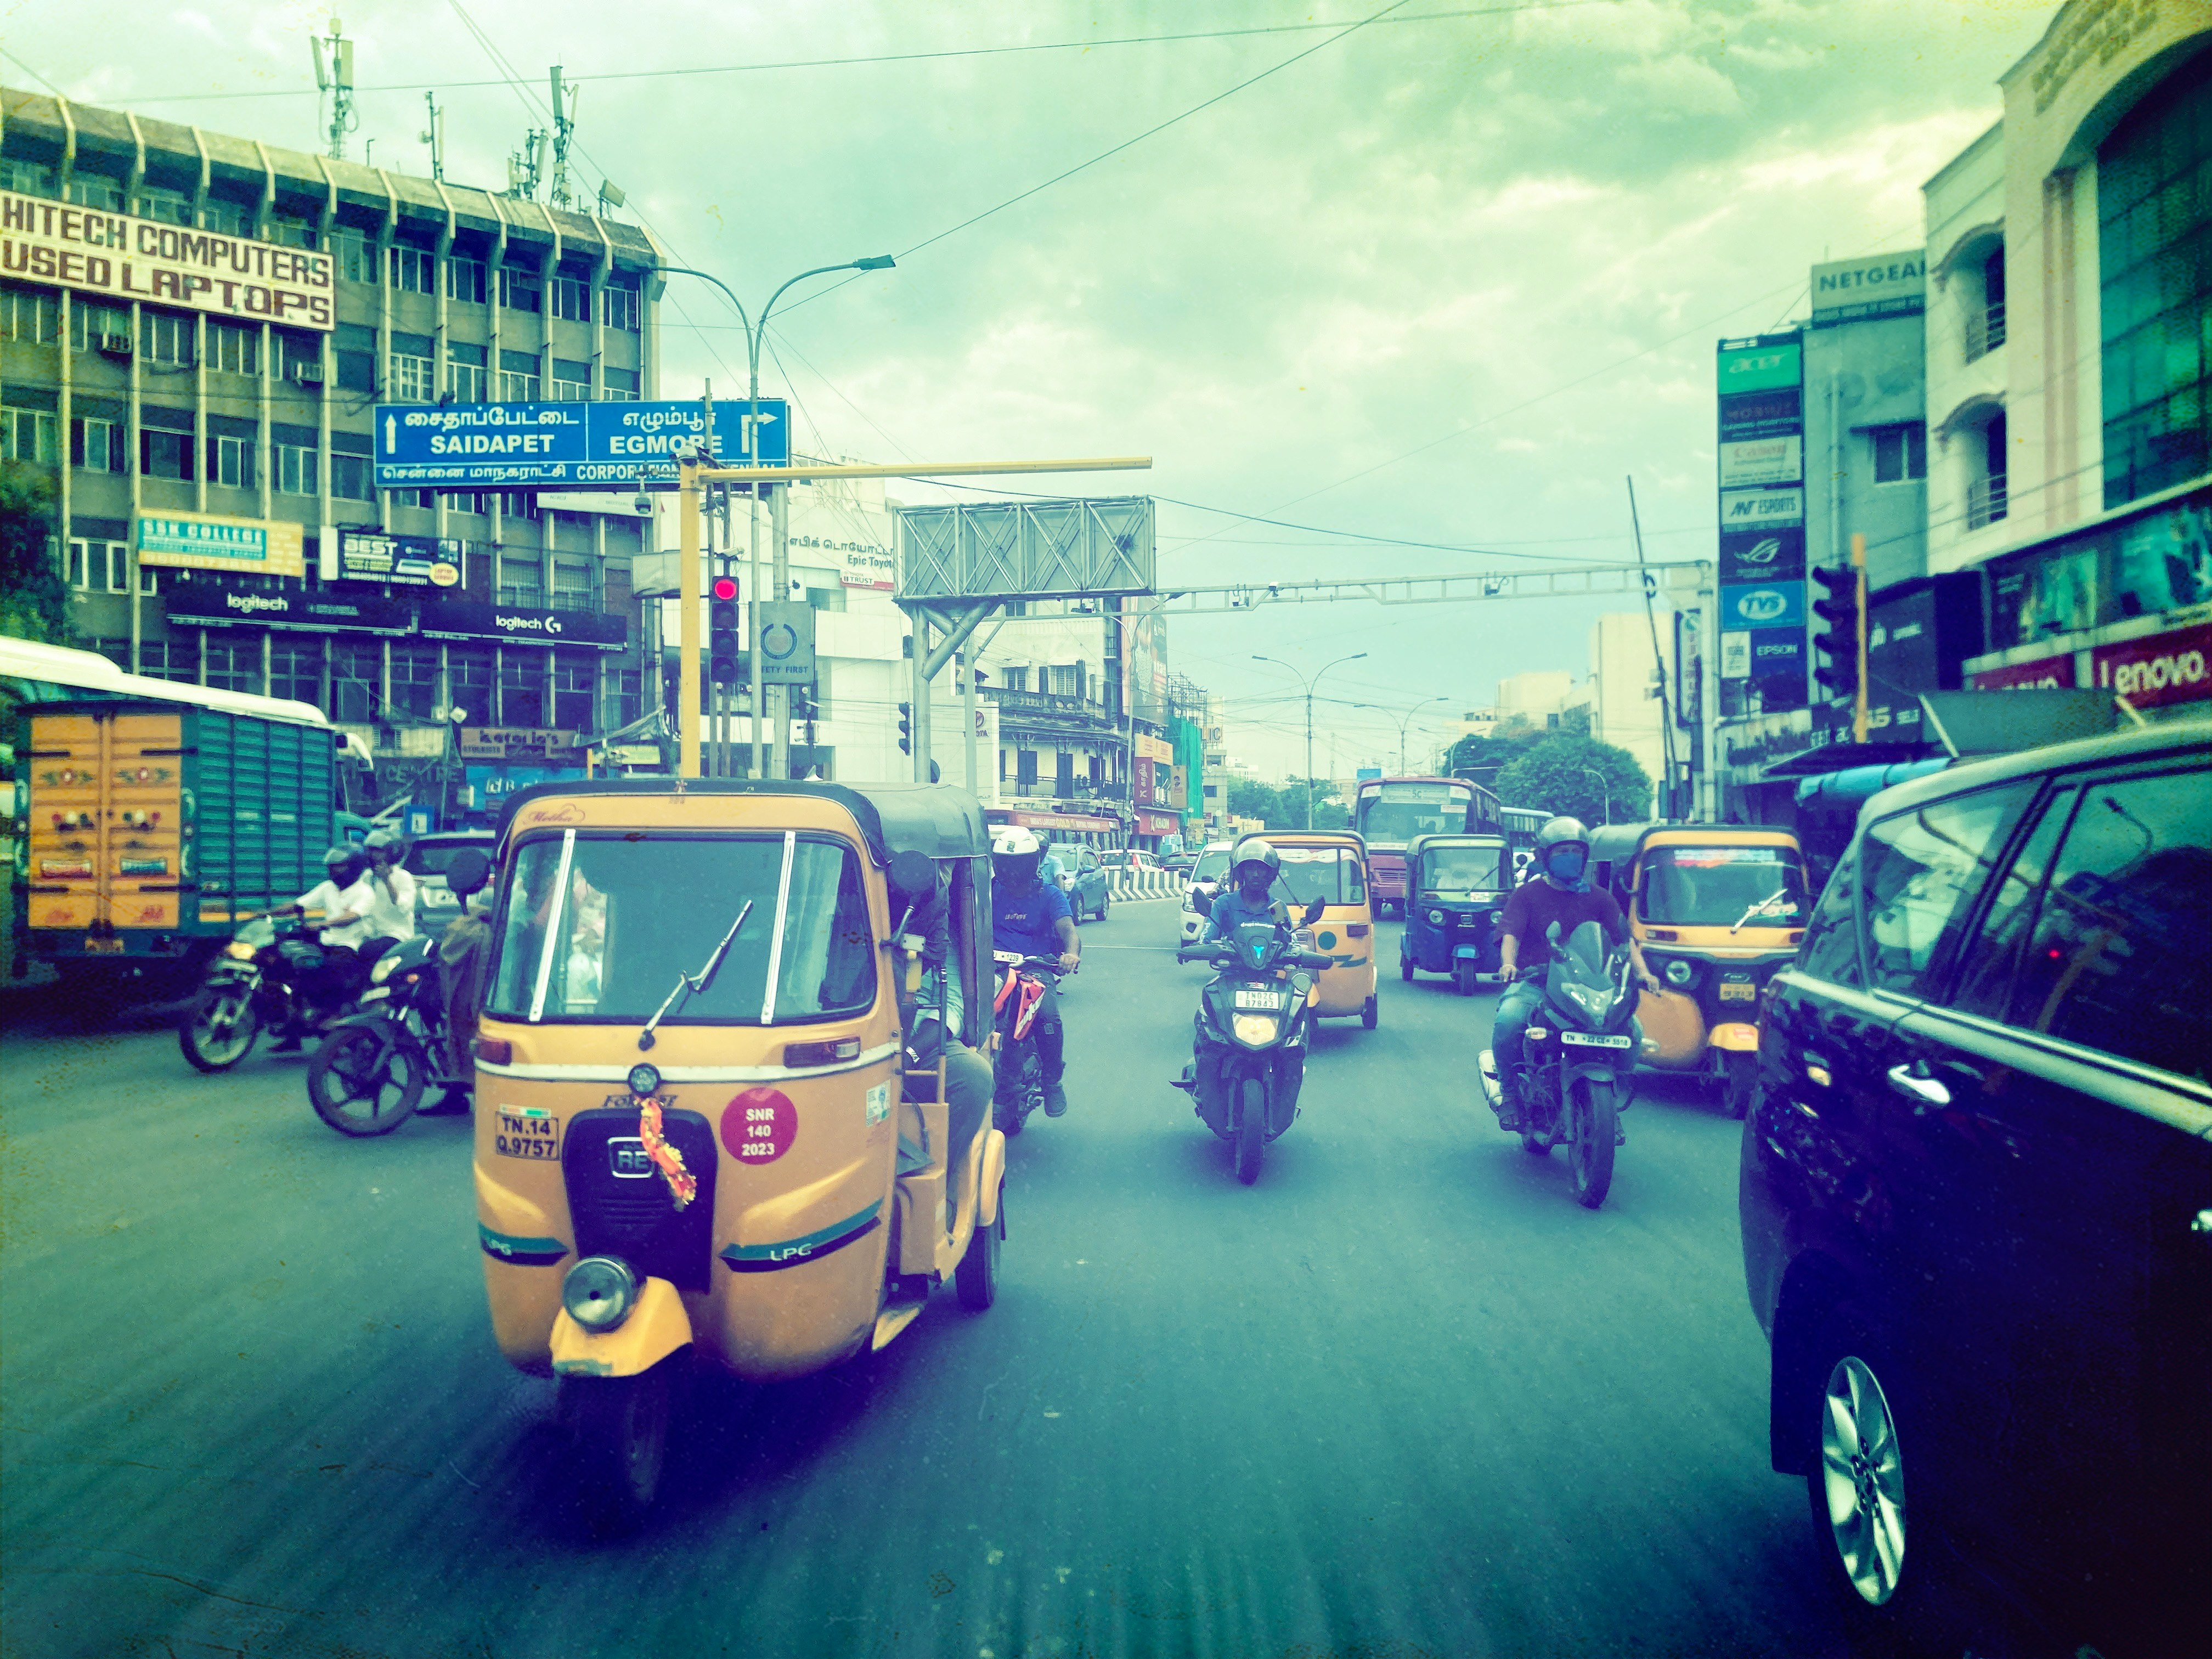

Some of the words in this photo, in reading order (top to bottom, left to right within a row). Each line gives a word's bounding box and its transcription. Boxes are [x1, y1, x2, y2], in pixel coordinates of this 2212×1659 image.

[3, 196, 126, 250] HITECH
[138, 224, 329, 288] COMPUTERS
[3, 240, 110, 287] USED
[121, 262, 329, 324] LAPTOPS
[405, 405, 579, 432] சைதாப்பேட்டை
[430, 434, 555, 455] SAIDAPET
[610, 435, 723, 455] EGMORE
[470, 462, 566, 482] மாநகராட்சி
[848, 554, 867, 567] Epic
[869, 556, 894, 569] Toyot
[227, 592, 289, 613] logitech
[495, 614, 542, 631] logitech
[761, 665, 780, 674] FETY
[786, 665, 809, 674] FIRST
[746, 1108, 775, 1121] SNR
[501, 1116, 551, 1135] TN.14
[747, 1125, 771, 1138] 140
[742, 1142, 775, 1156] 2023
[618, 1150, 649, 1170] RE
